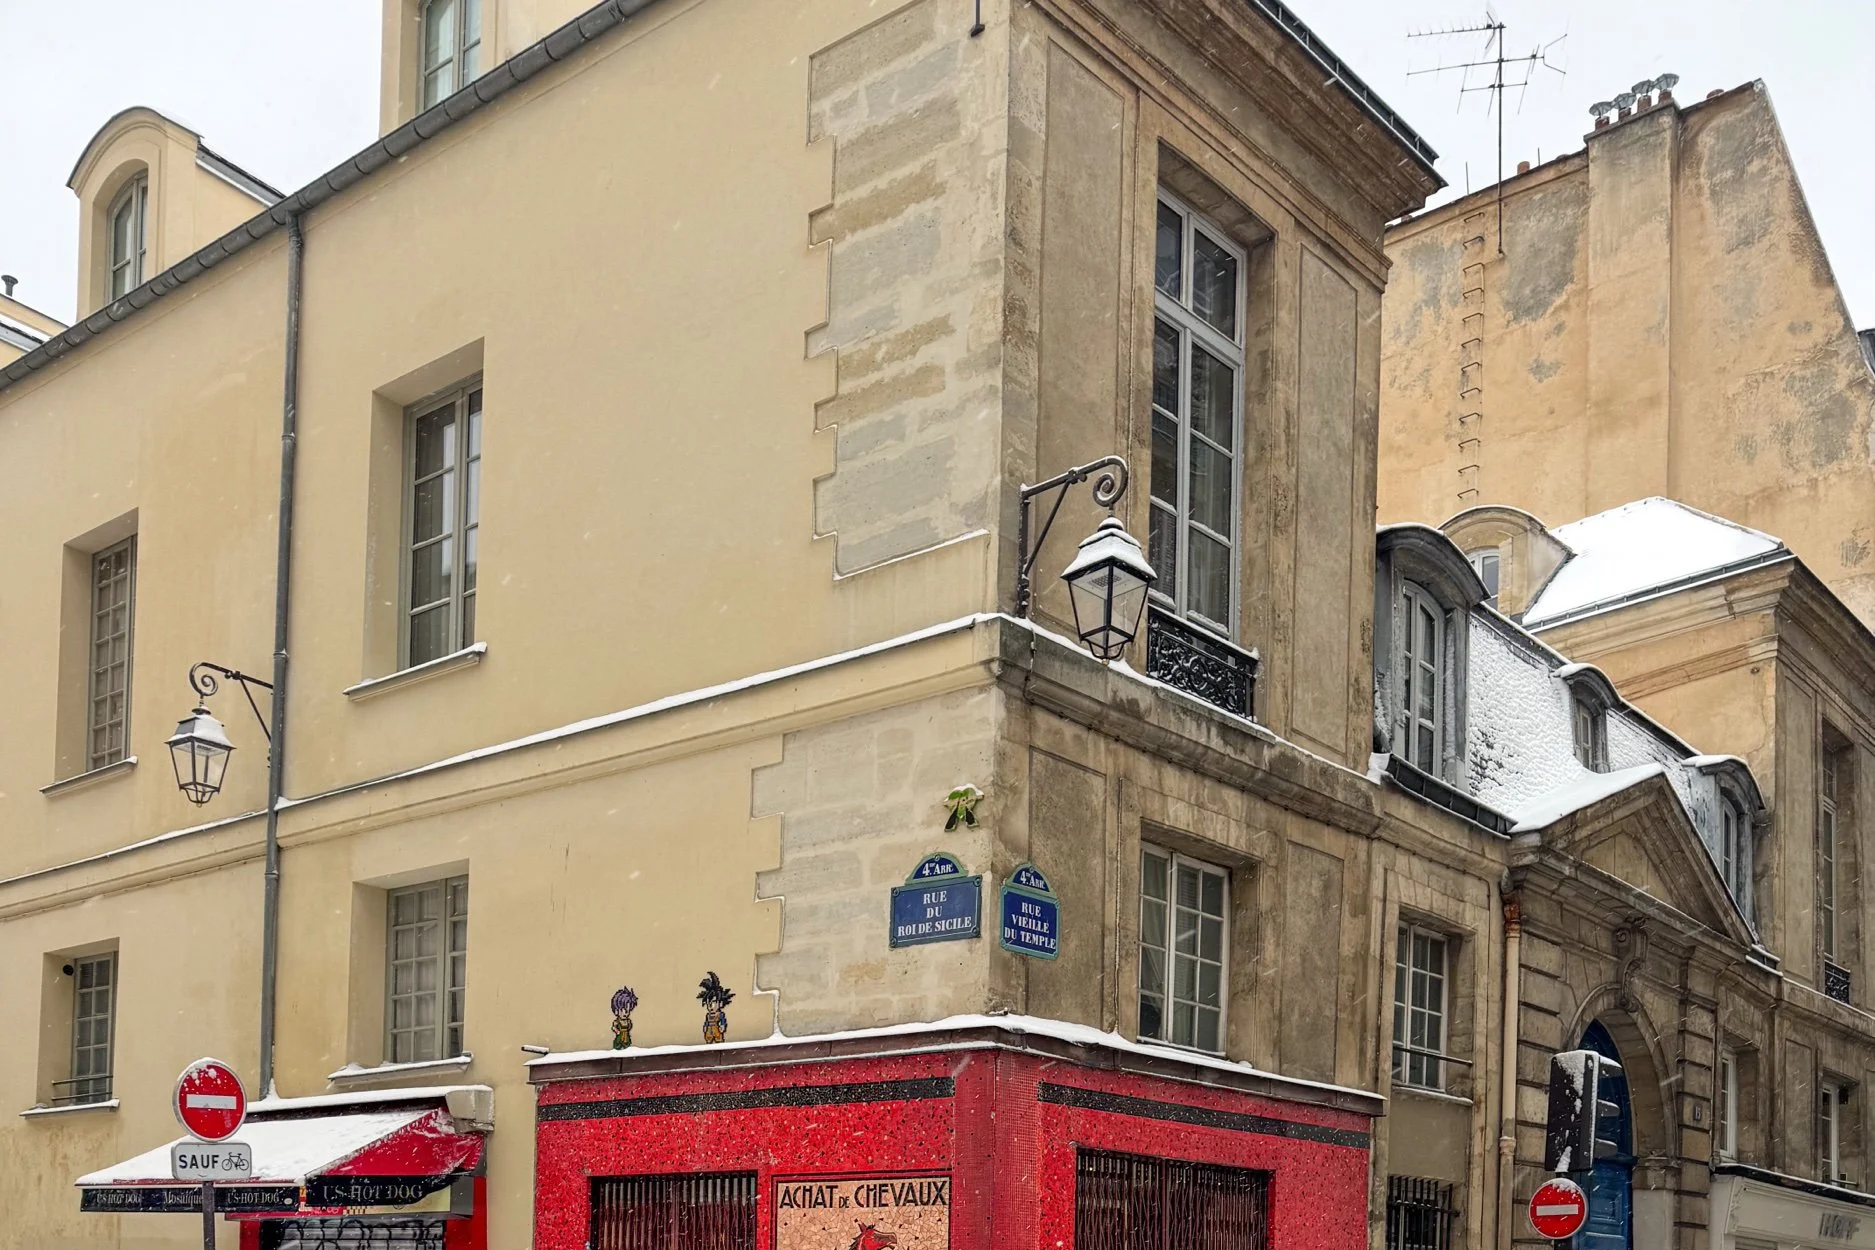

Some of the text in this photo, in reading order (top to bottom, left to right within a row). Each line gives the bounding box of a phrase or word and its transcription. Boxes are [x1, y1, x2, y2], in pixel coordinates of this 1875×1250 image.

[923, 890, 947, 905] RUE
[926, 906, 942, 919] DU
[1021, 902, 1042, 917] RUE
[897, 916, 972, 937] ROI DE SICILE
[1011, 913, 1050, 934] VIEILLE
[1004, 927, 1056, 950] DU TEMPLE
[178, 1154, 220, 1169] SAUF
[125, 1193, 142, 1204] DOG
[241, 1192, 259, 1204] HOT
[261, 1191, 280, 1204] DOG
[350, 1185, 383, 1201] HOT
[386, 1184, 423, 1200] DOG
[779, 1180, 948, 1209] ACHAT DE CHEVAUX
